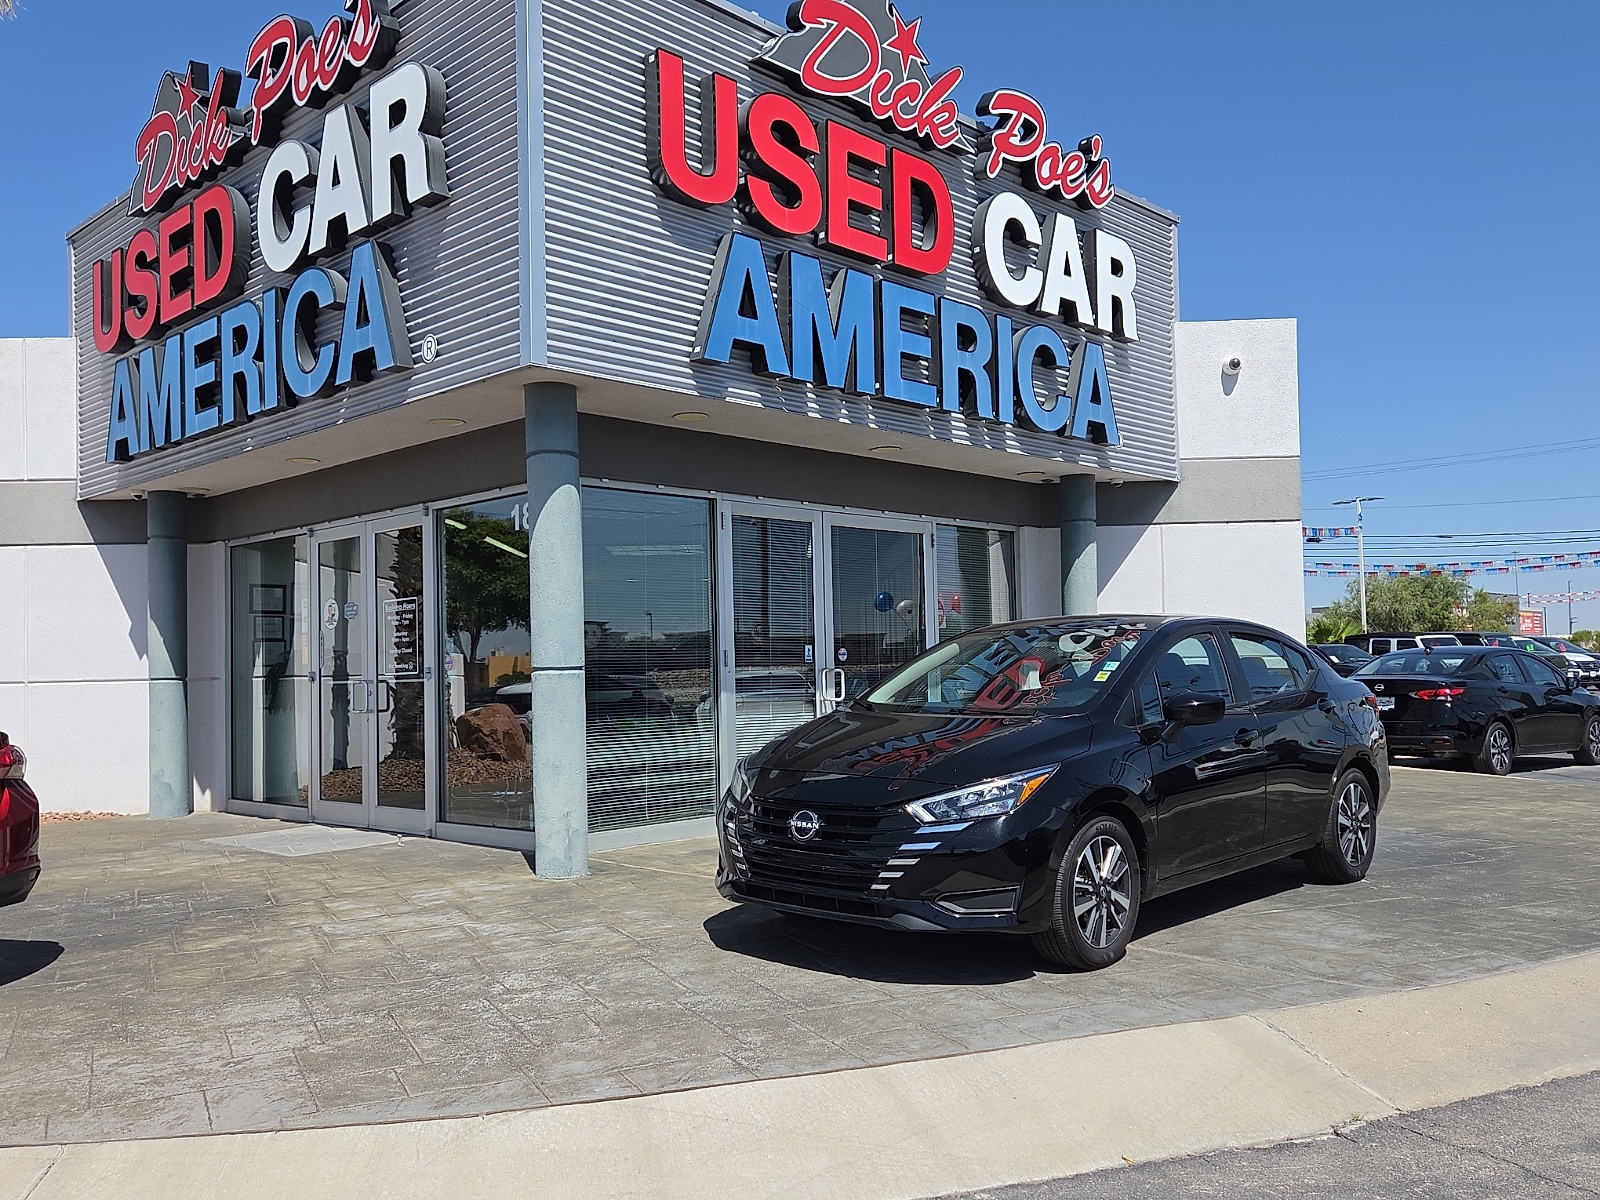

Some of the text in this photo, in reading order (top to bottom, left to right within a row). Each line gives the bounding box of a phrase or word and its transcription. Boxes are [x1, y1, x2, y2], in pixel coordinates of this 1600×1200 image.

[92, 61, 436, 353] USED CAR
[136, 66, 236, 212] Dick
[656, 47, 1140, 342] USED CAR
[799, 0, 1114, 209] Dick Poe's
[105, 239, 396, 463] AMERICA
[702, 231, 1120, 446] AMERICA
[789, 819, 820, 830] NISSAN
